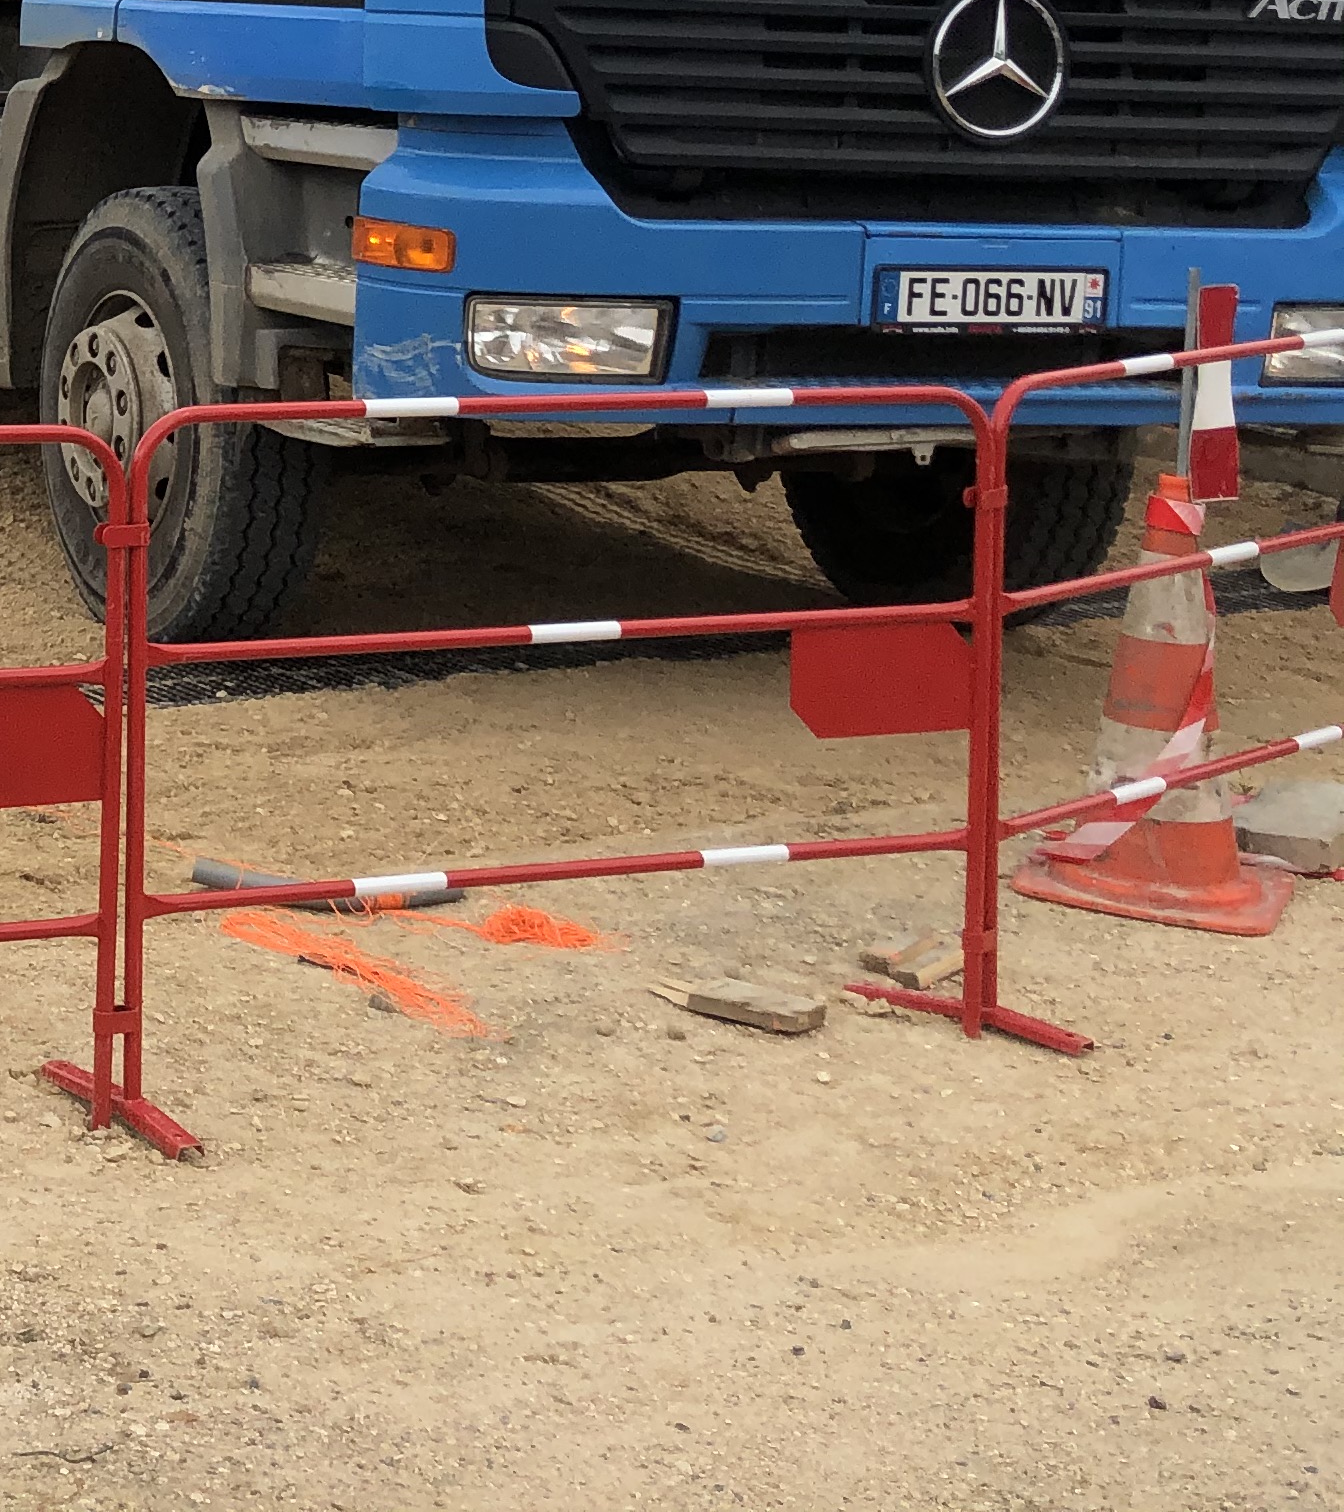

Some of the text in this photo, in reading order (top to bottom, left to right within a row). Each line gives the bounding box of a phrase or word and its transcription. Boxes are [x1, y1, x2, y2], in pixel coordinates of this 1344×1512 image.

[883, 277, 1102, 319] F FE-066-NV 91
